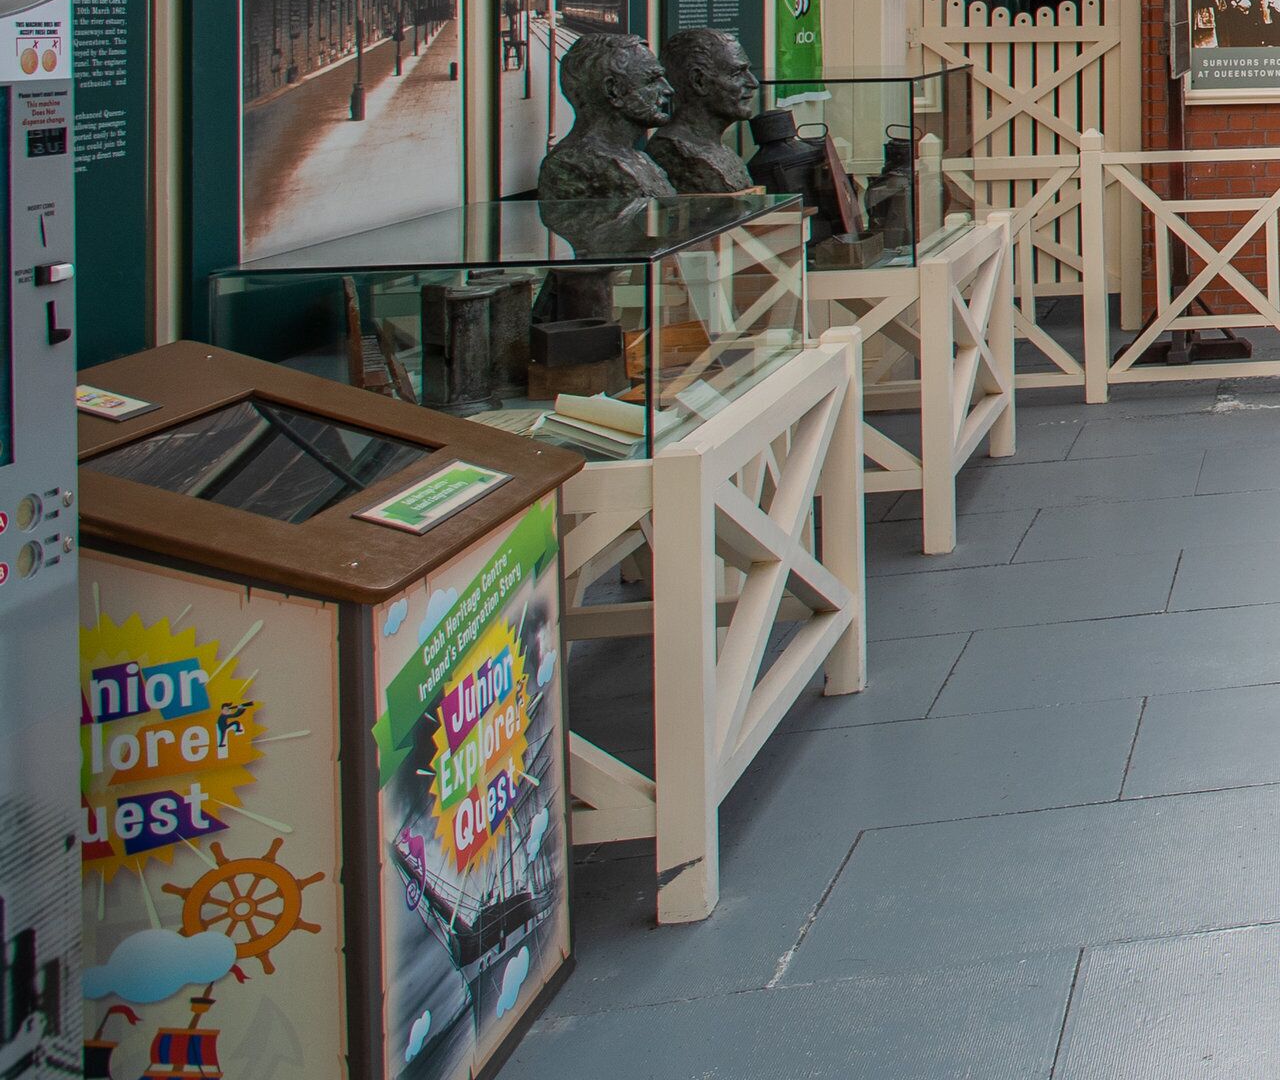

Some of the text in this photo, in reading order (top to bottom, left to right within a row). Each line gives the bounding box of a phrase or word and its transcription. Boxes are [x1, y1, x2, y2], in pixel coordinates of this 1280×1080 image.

[1198, 70, 1209, 78] AT
[1214, 69, 1280, 78] QUEENSTOWN
[1203, 59, 1259, 67] SURVIVORS
[423, 553, 508, 665] Cobh Heritage Centre
[457, 592, 499, 652] Emigration
[500, 562, 522, 598] Story
[90, 664, 209, 718] nior
[451, 653, 513, 733] Junior
[91, 722, 245, 774] lorer
[441, 692, 525, 803] Explorer
[82, 783, 210, 844] uest
[455, 756, 517, 851] Quest
